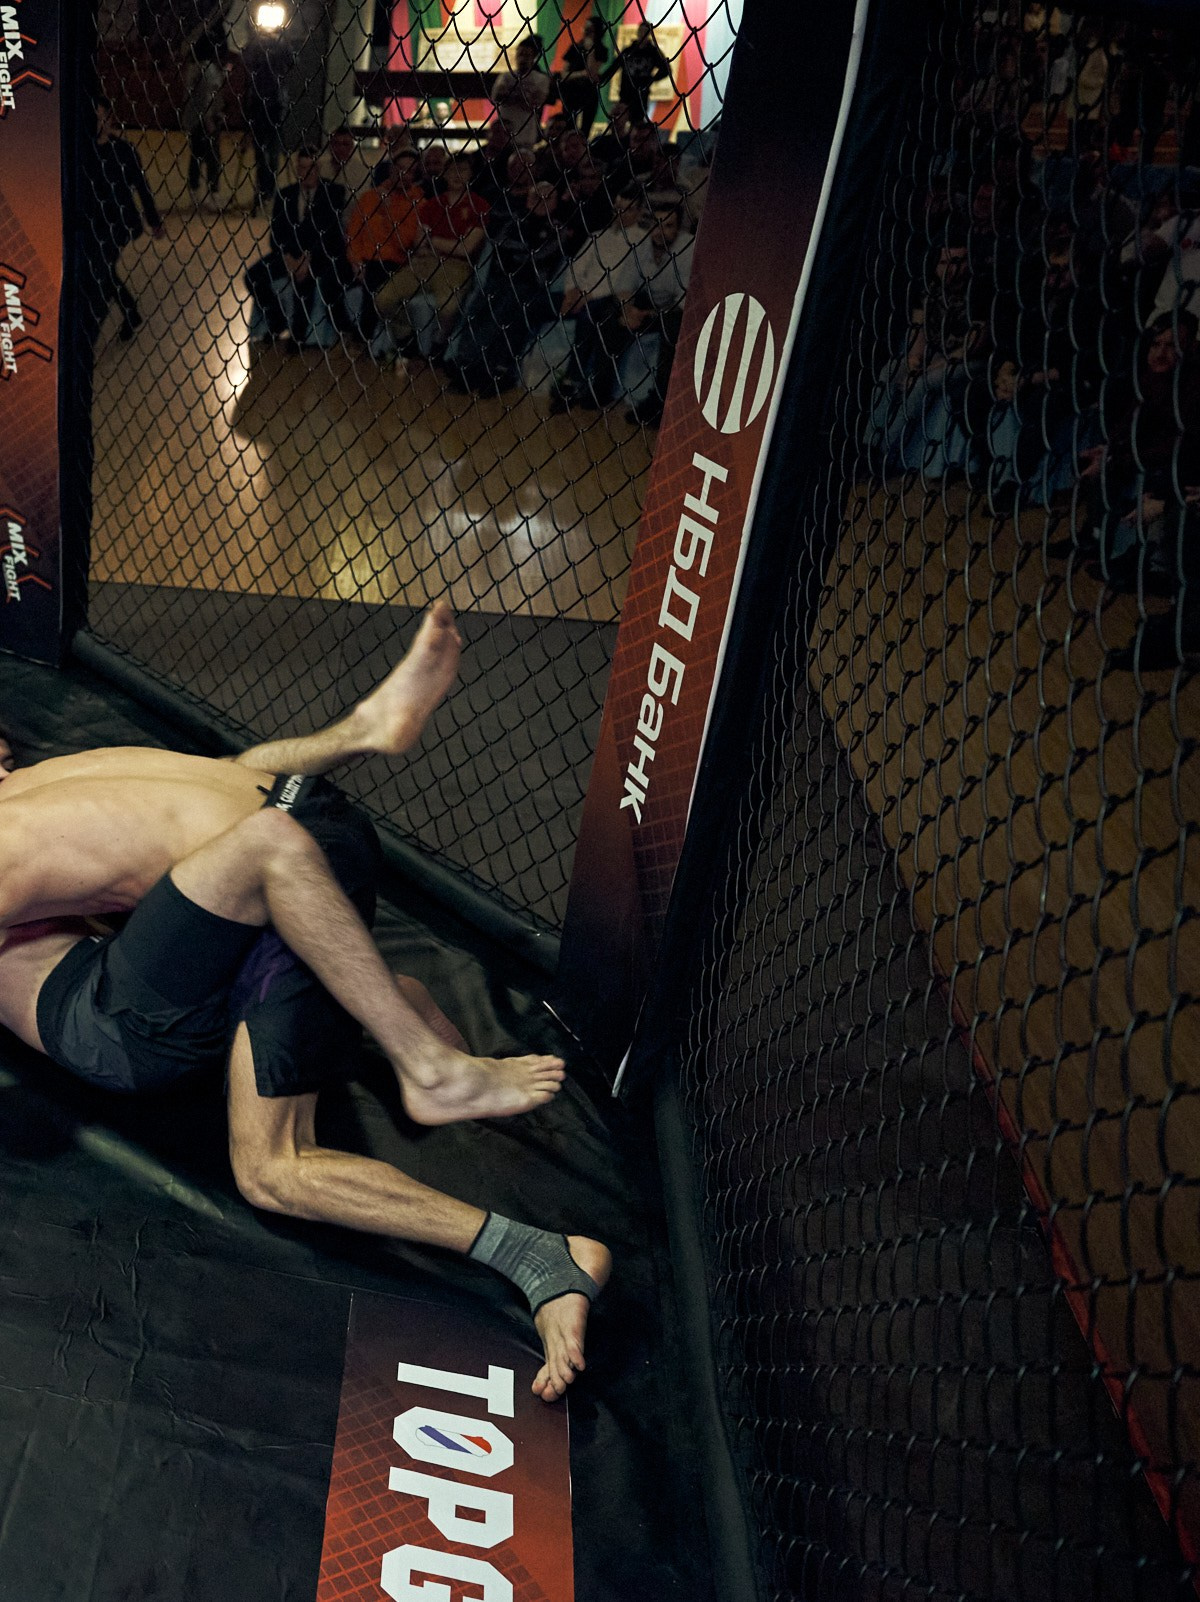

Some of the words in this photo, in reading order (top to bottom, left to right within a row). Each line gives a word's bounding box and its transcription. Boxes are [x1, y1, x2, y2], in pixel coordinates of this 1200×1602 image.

[0, 5, 24, 60] MIX
[3, 283, 25, 332] MIX
[0, 322, 18, 374] FIGHT
[7, 520, 29, 566] MIX
[658, 451, 729, 642] НБД
[3, 554, 21, 602] FIGHT
[619, 642, 686, 825] Банк
